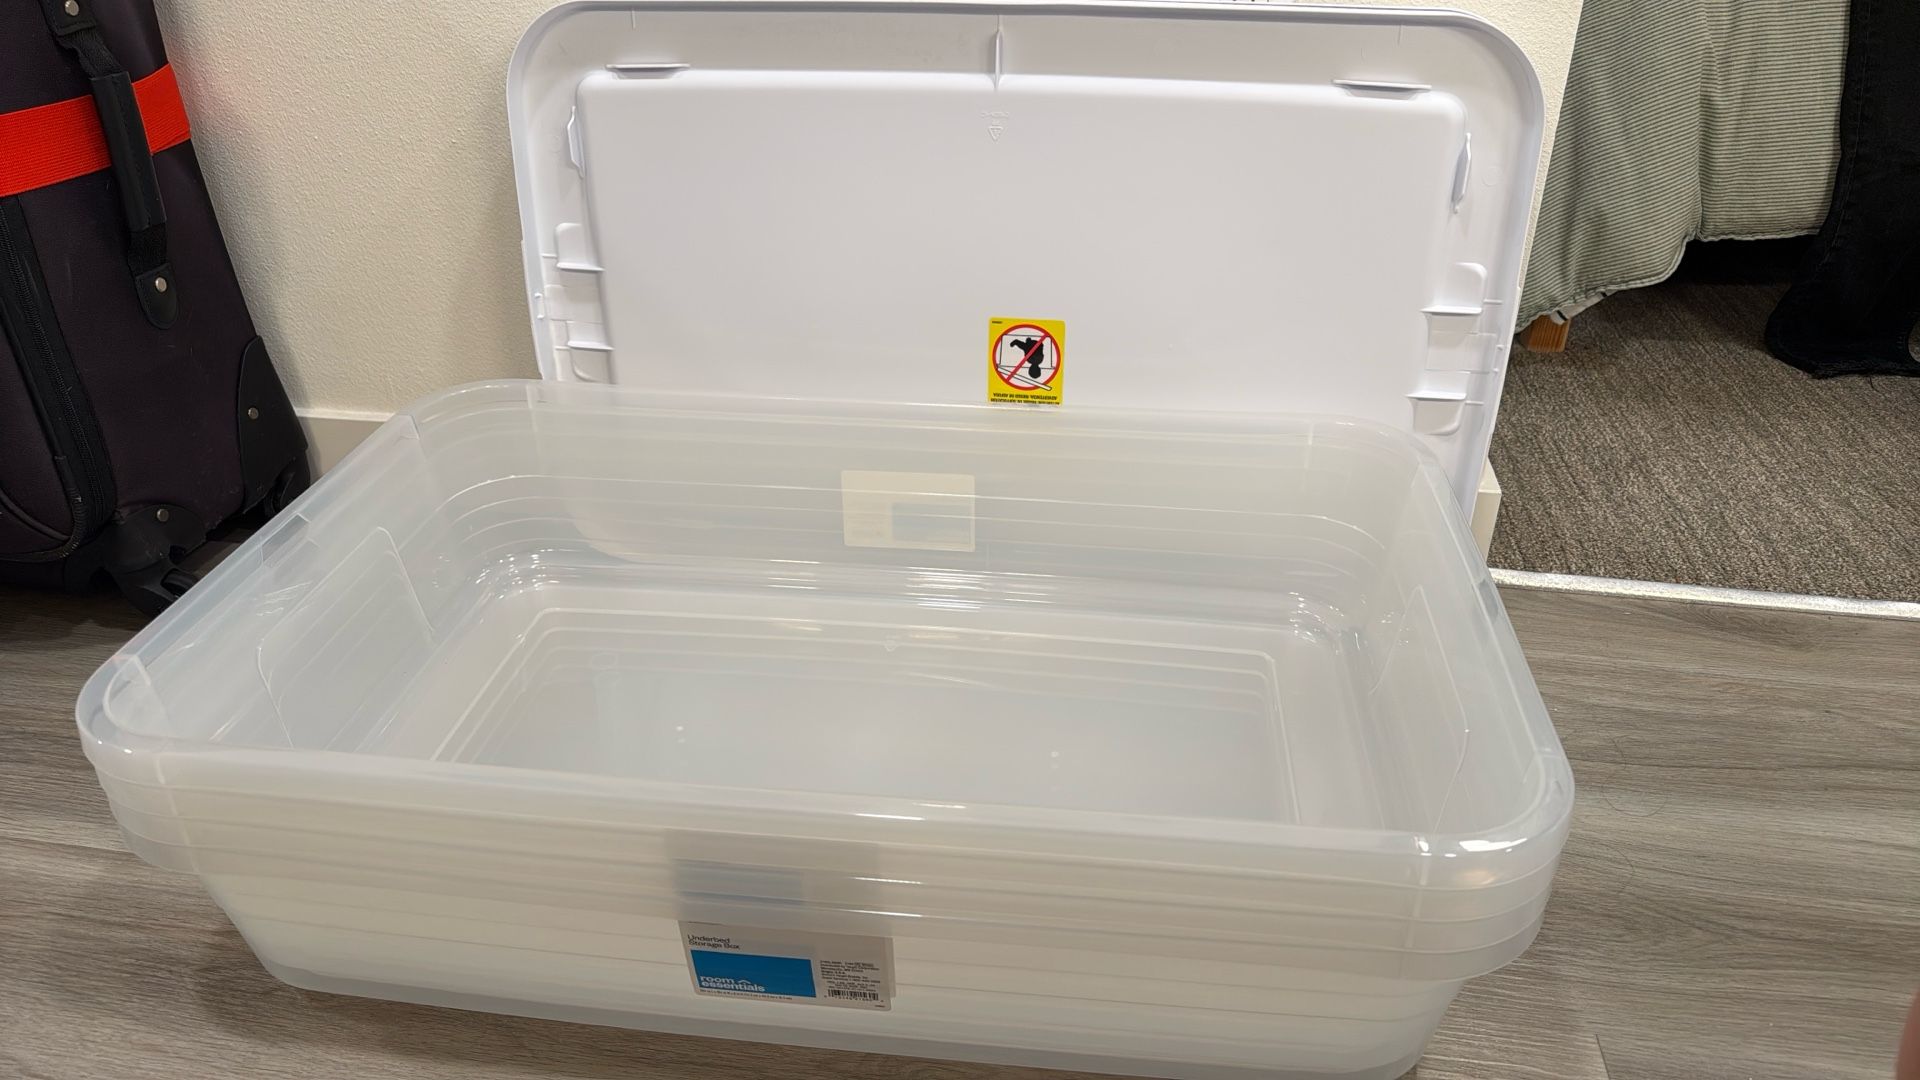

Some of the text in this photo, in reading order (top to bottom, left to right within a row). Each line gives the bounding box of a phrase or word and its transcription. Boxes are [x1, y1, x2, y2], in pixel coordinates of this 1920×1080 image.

[688, 934, 730, 943] Underbed
[689, 940, 722, 948] Storage
[700, 976, 735, 984] room
[701, 981, 766, 992] essentials
